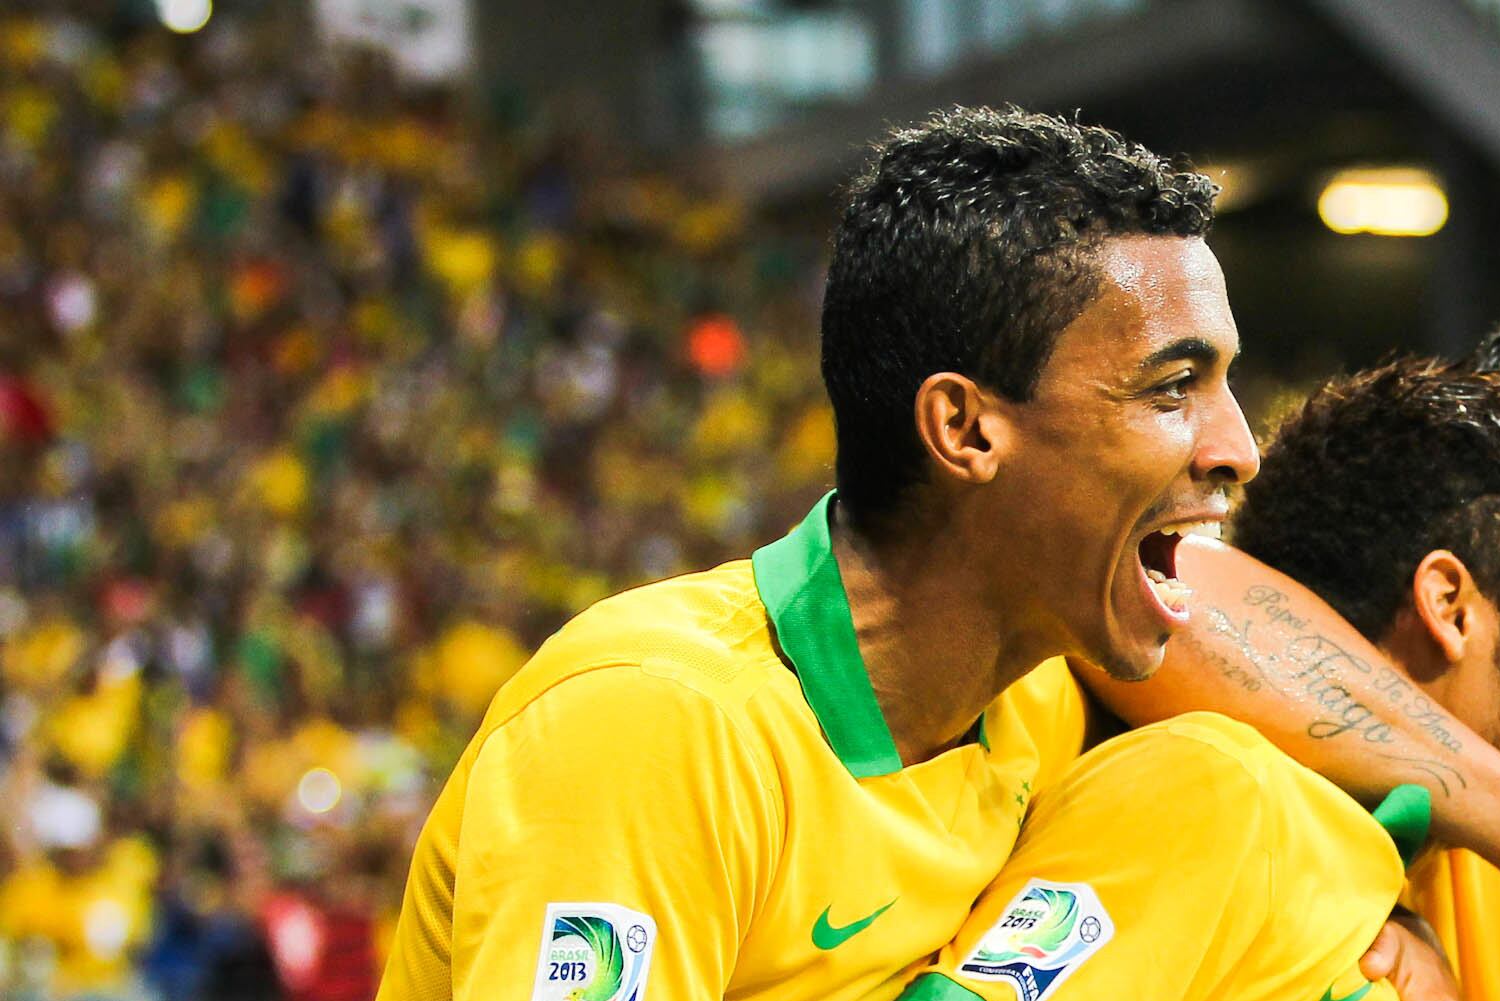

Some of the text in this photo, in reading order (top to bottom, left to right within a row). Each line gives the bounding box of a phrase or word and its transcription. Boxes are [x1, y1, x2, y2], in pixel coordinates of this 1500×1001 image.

[1001, 916, 1037, 929] 2013
[551, 950, 588, 960] BRASIL
[549, 962, 586, 981] 2013
